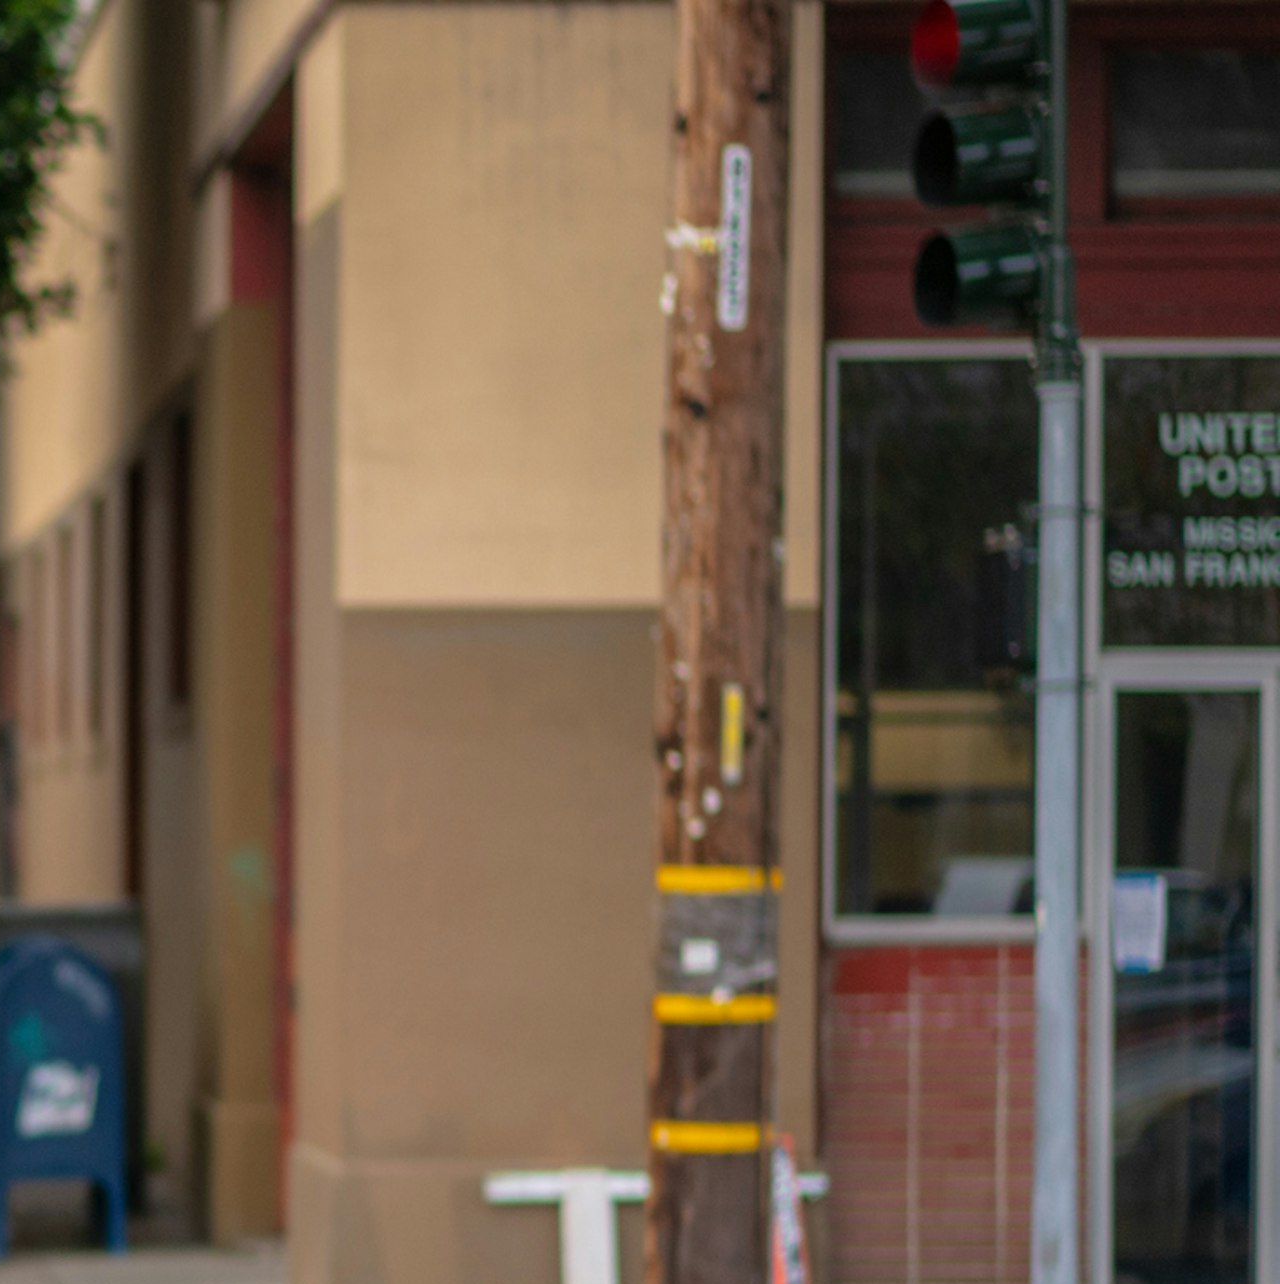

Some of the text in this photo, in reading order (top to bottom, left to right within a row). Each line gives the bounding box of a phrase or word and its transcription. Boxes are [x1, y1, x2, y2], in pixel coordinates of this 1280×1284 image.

[1158, 412, 1280, 455] UNITE
[1178, 454, 1280, 497] POST
[1107, 551, 1174, 588] SAN
